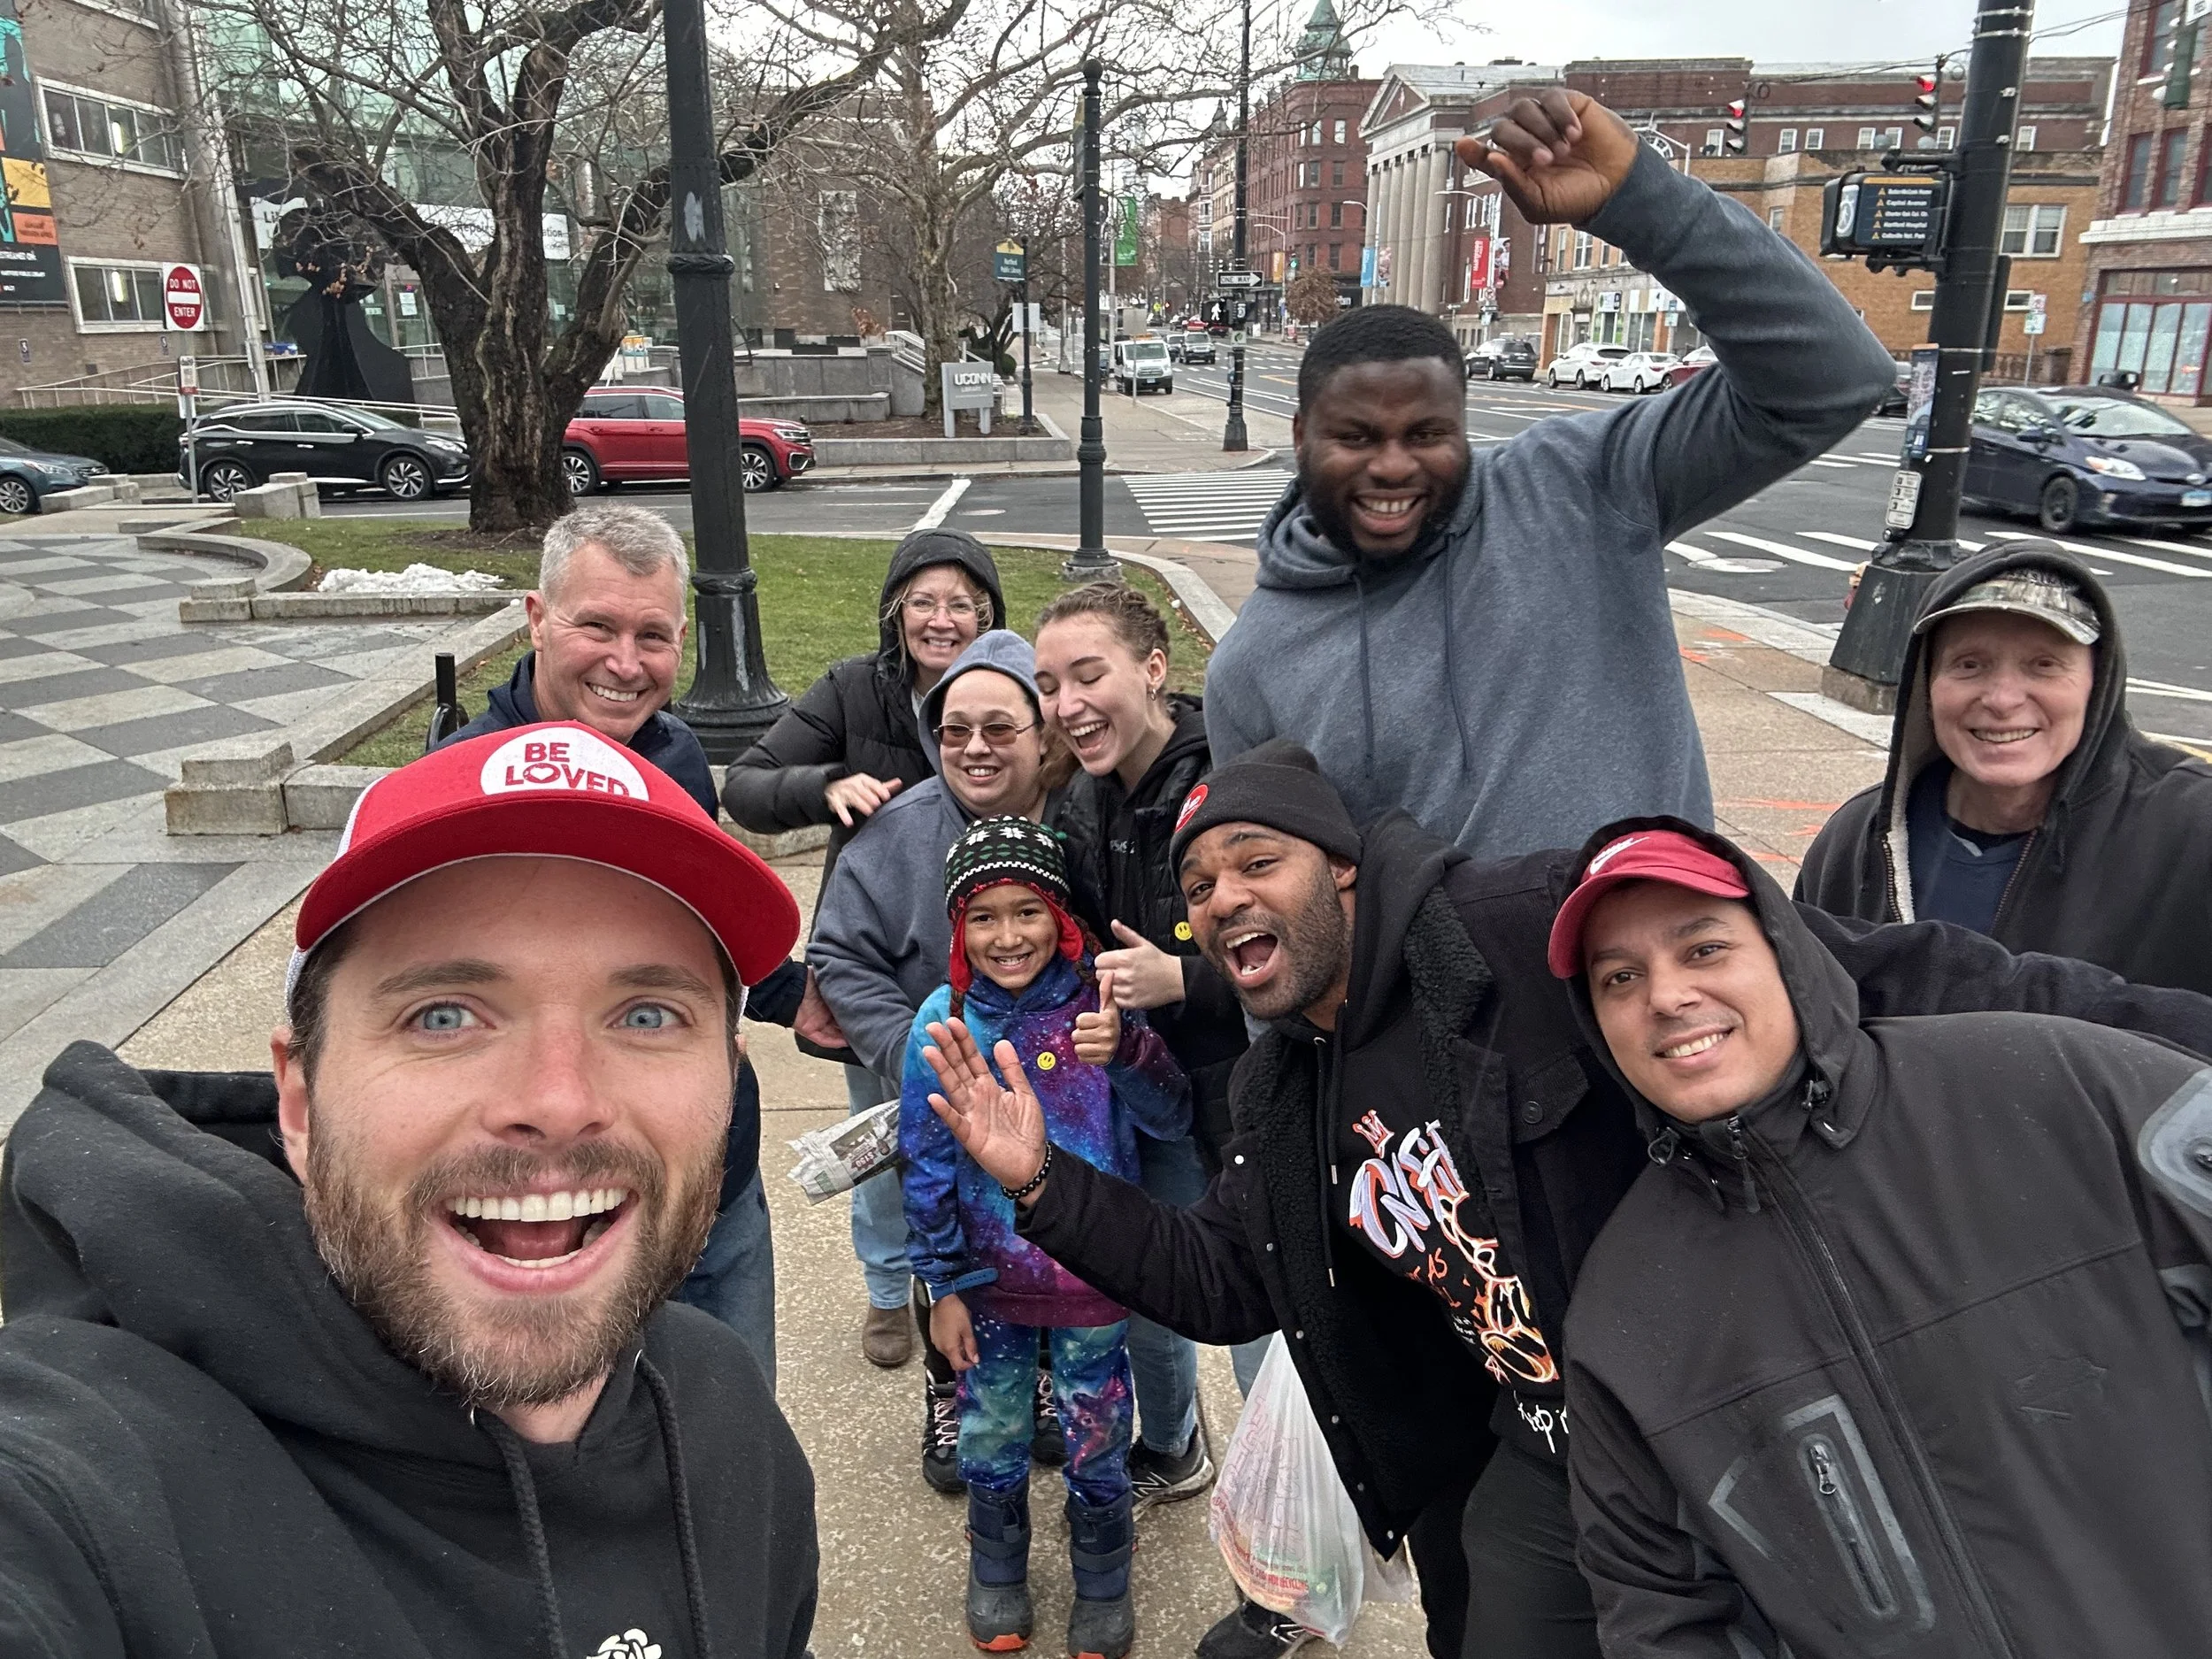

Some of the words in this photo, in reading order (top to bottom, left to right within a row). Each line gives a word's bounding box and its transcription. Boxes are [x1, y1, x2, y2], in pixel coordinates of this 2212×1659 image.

[169, 278, 180, 289] DO
[181, 279, 196, 290] NOT
[173, 306, 196, 318] ENTER
[955, 372, 992, 386] UCONN
[524, 742, 571, 764] BE
[504, 762, 630, 797] LOVED
